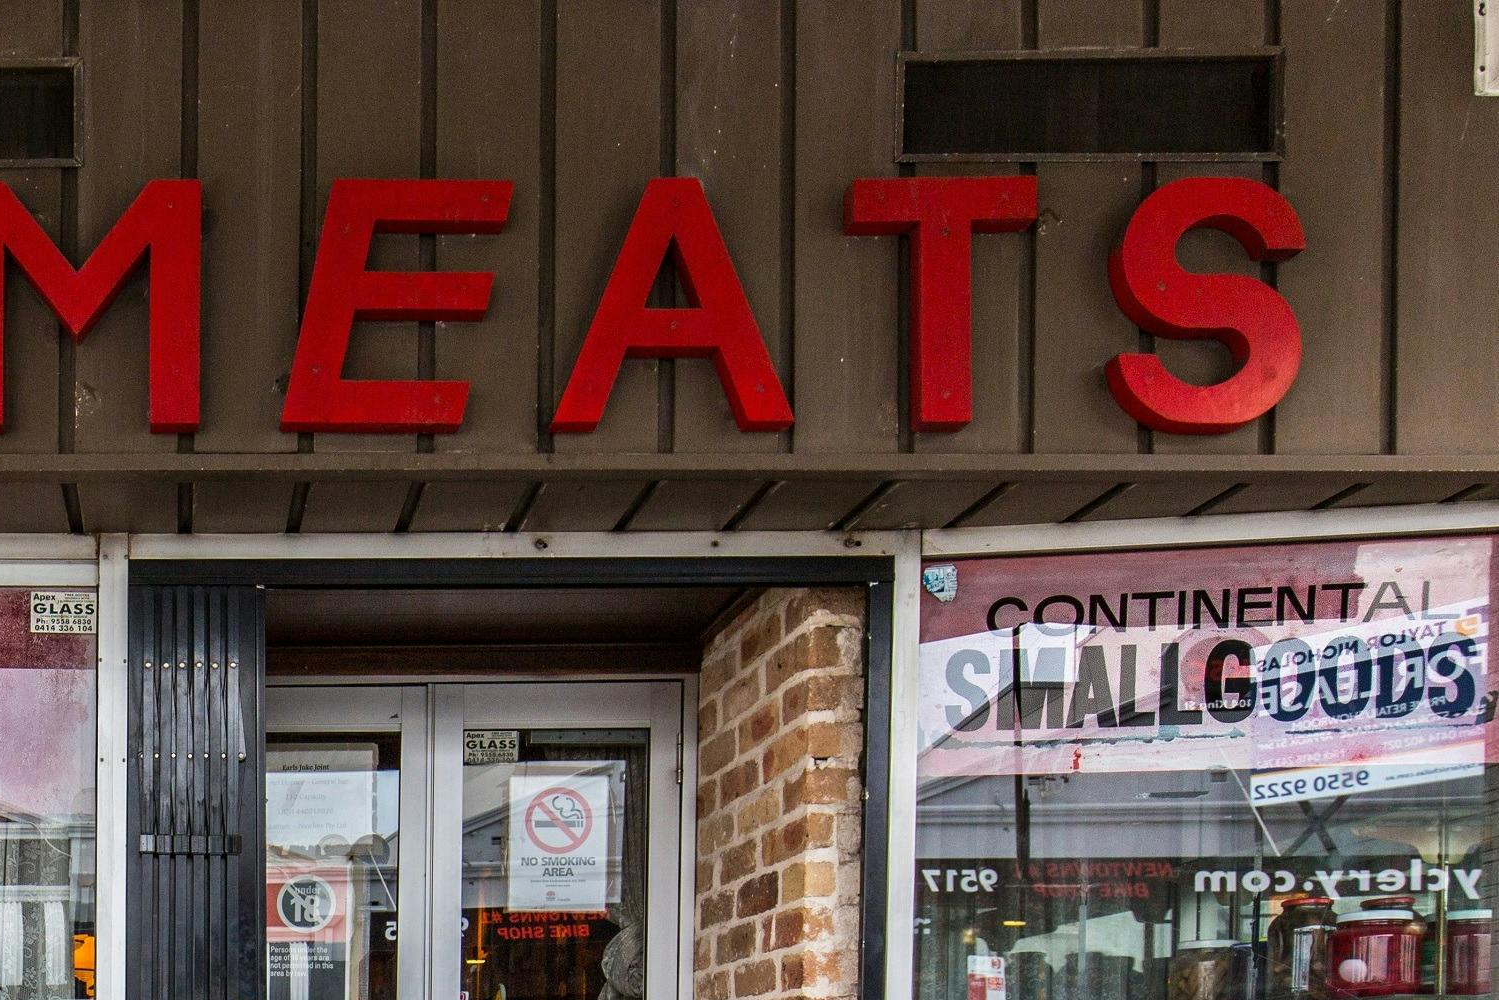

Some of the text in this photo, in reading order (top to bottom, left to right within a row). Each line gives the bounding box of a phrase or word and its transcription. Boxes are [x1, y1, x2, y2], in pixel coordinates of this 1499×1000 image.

[33, 593, 56, 601] Apex
[33, 603, 95, 615] GLASS
[985, 580, 1461, 637] CONTINENTAL
[466, 740, 516, 749] GLASS
[520, 856, 596, 866] NO SMOKING
[542, 868, 574, 877] AREA
[290, 894, 322, 923] 18
